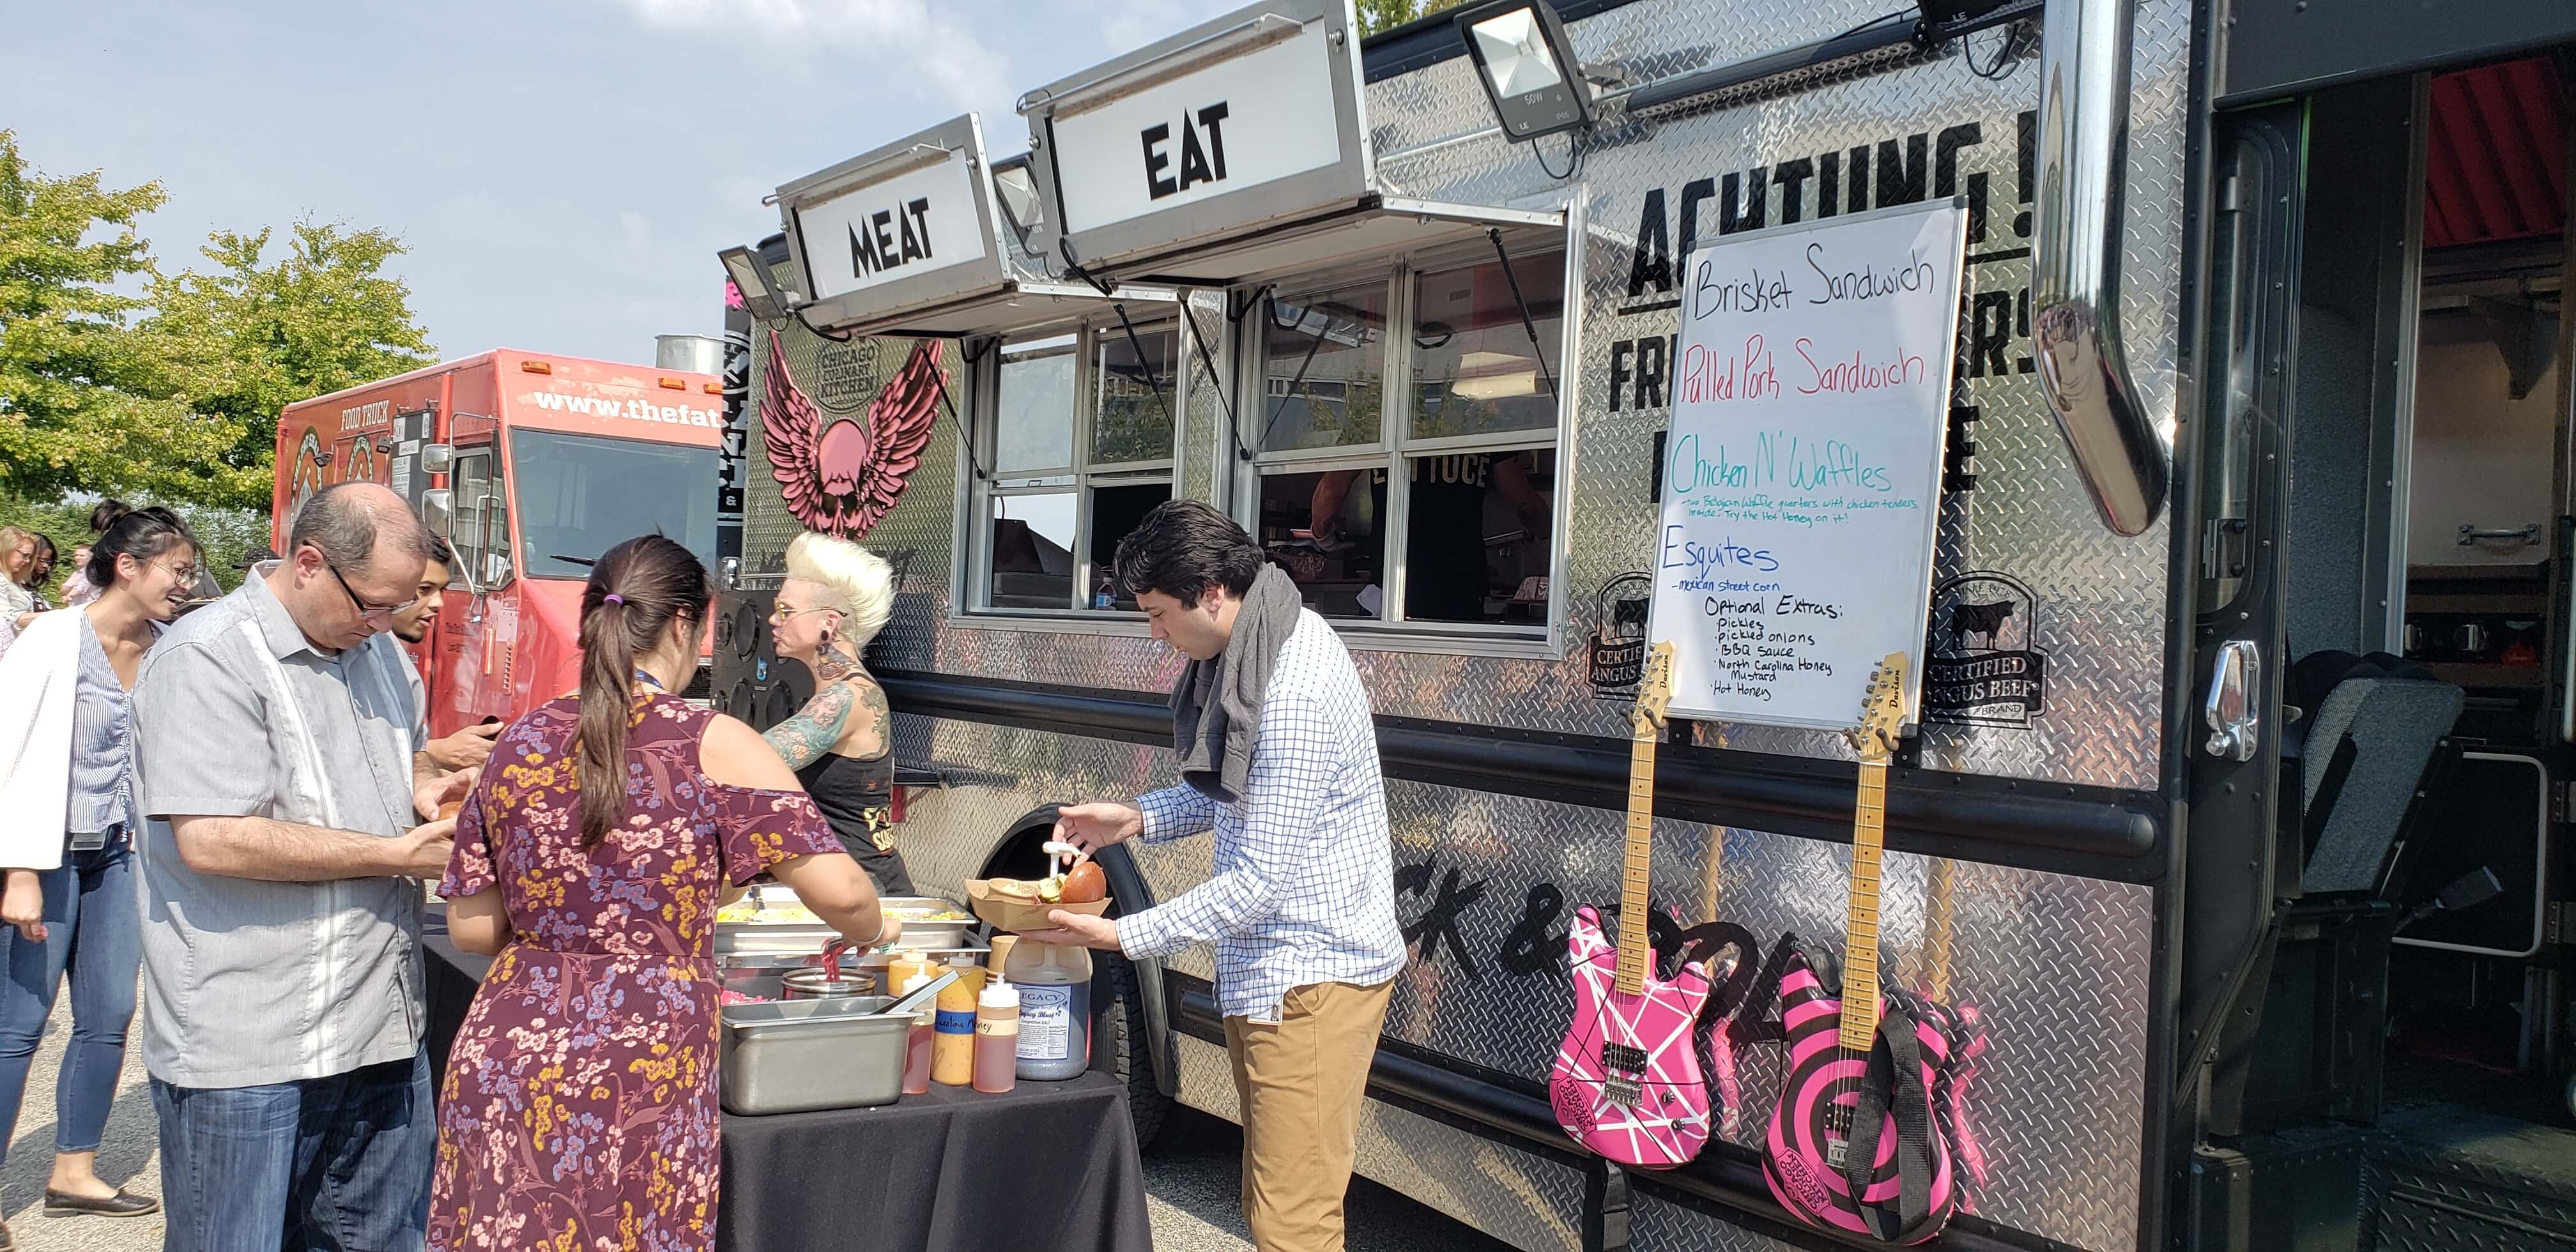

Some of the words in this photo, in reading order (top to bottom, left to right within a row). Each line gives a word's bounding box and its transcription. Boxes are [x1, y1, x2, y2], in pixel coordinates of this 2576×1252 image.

[1524, 91, 1544, 105] 50W
[1140, 100, 1229, 201] EAT
[848, 197, 933, 279] MEAT
[1694, 260, 1793, 320] Brisket
[1806, 242, 1935, 304] Sandwich
[822, 346, 875, 369] CHICAGO
[1682, 344, 1733, 403] Pulled
[1742, 333, 1780, 400] Pork
[1795, 337, 1924, 395] Sandwich
[821, 377, 873, 398] KITCHEN
[341, 406, 361, 431] FOOD
[362, 401, 389, 426] TRUCK
[533, 391, 723, 429] www.thefat
[1671, 434, 1747, 493] Chicken
[1789, 436, 1892, 491] Waffles
[1703, 494, 1740, 511] Belgian
[1742, 494, 1774, 509] Waffle
[1778, 496, 1818, 512] quarters
[1822, 496, 1843, 508] with
[1846, 498, 1879, 510] chicken
[1881, 498, 1918, 509] tenders
[1724, 510, 1740, 522] Try
[1742, 510, 1759, 520] the
[1762, 512, 1777, 521] Hot
[1782, 512, 1813, 529] Honey
[1662, 525, 1779, 580] Esquites
[1753, 583, 1781, 592] corn
[1705, 596, 1765, 616] Optional
[1775, 595, 1843, 619] Extras:
[1717, 629, 1764, 643] pickled
[1768, 632, 1815, 645] onions
[1721, 643, 1751, 656] BBQ
[1591, 664, 1636, 682] ANGUS
[1659, 654, 1669, 689] Davison
[1718, 659, 1749, 671] North
[1754, 659, 1795, 671] Carolina
[1798, 657, 1832, 675] Honey
[1730, 670, 1777, 682] Mustard
[1929, 657, 2027, 682] CERTIFIED
[1713, 680, 1732, 695] Hot
[1737, 682, 1772, 701] Honey
[1889, 669, 1900, 708] Davison
[1982, 704, 2021, 716] BRAND
[1022, 993, 1060, 1001] EGACY
[1560, 1085, 1586, 1131] CHICAGO
[1565, 1087, 1589, 1127] CULINARY
[1567, 1080, 1595, 1127] KITCHEN
[1780, 1161, 1817, 1209] CHICAGO
[1787, 1161, 1820, 1203] CULINARY
[1788, 1153, 1827, 1203] KITCHEN
